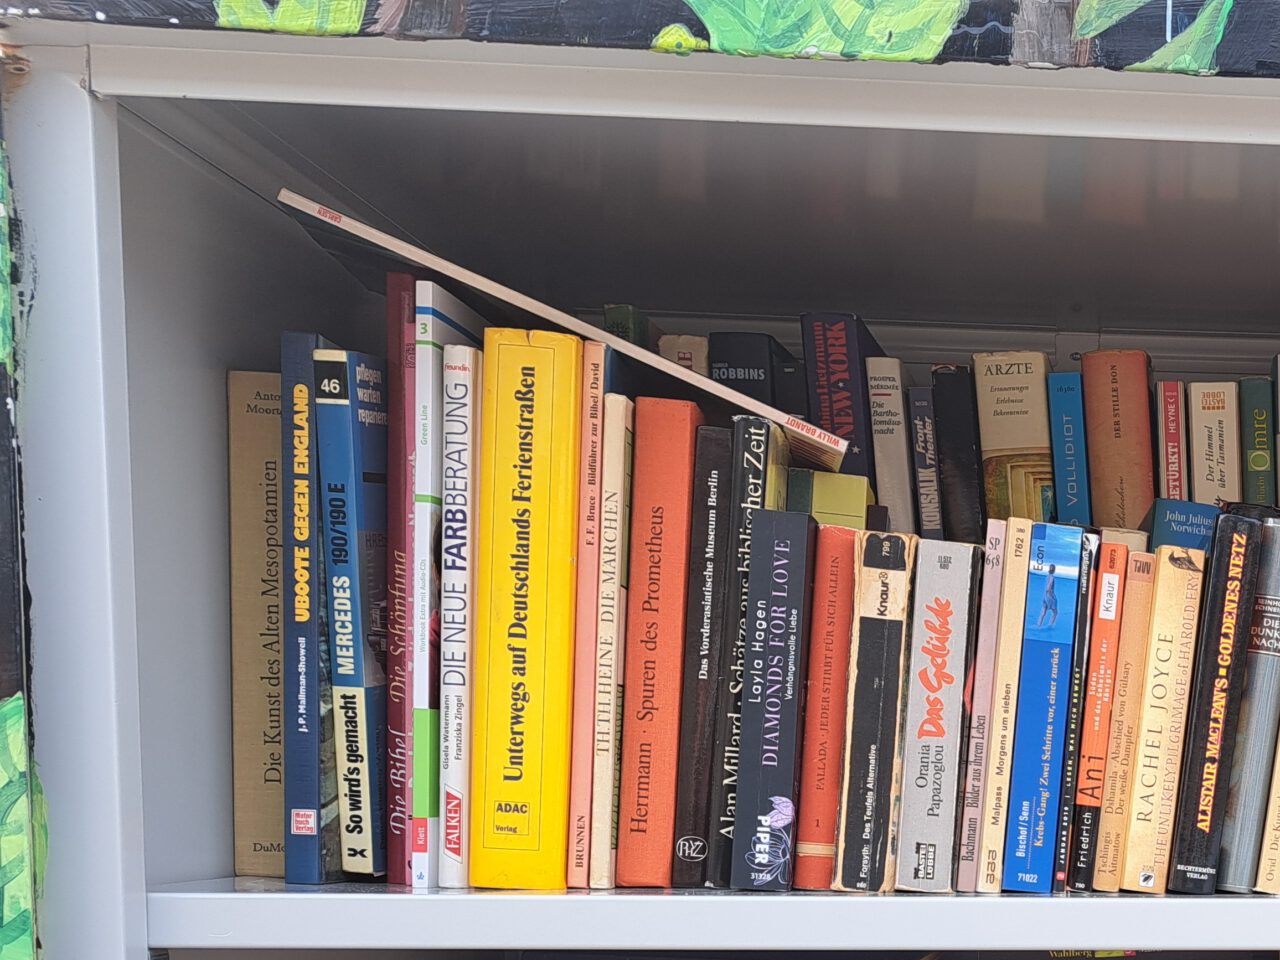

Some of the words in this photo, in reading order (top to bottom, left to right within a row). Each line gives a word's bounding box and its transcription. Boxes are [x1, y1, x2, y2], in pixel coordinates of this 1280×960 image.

[984, 362, 1032, 376] ÄRZTE
[292, 384, 309, 475] ENGLAND
[511, 366, 536, 504] Ferienstraßen
[443, 383, 469, 572] FARBBERATUNG
[707, 470, 719, 506] Berlin
[260, 460, 283, 600] Mesopotamien
[294, 481, 309, 541] GEGEN
[704, 510, 718, 558] Museum
[294, 547, 309, 621] UBOOTE
[507, 508, 533, 640] Deutschlands
[643, 506, 665, 614] Prometheus
[771, 540, 791, 597] LOVE
[262, 605, 281, 655] Alten
[332, 575, 355, 675] MERCEDES
[443, 582, 468, 645] NEUE
[640, 621, 659, 651] des
[699, 561, 715, 656] Vorderasiatische
[751, 600, 769, 651] Hagen
[768, 606, 788, 648] FOR
[263, 660, 281, 691] des
[443, 652, 467, 687] DIE
[506, 645, 527, 677] auf
[697, 659, 709, 679] Das
[749, 660, 766, 703] Layla
[1197, 762, 1219, 833] ALISTAIR
[1208, 678, 1228, 758] MACLEAN'S
[1218, 580, 1240, 665] GOLDENES
[1230, 533, 1246, 578] NETZ
[637, 659, 661, 722] Spuren
[761, 656, 784, 767] DIAMONDS
[263, 693, 281, 747] Kunst
[338, 694, 363, 766] gemacht
[504, 682, 530, 782] Unterwegs
[1137, 724, 1163, 821] RACHEL
[1150, 633, 1174, 710] JOYCE
[263, 752, 281, 785] Die
[342, 770, 362, 813] wird's
[630, 742, 653, 835] Herrmann
[345, 815, 363, 835] So
[445, 798, 461, 850] FALKEN
